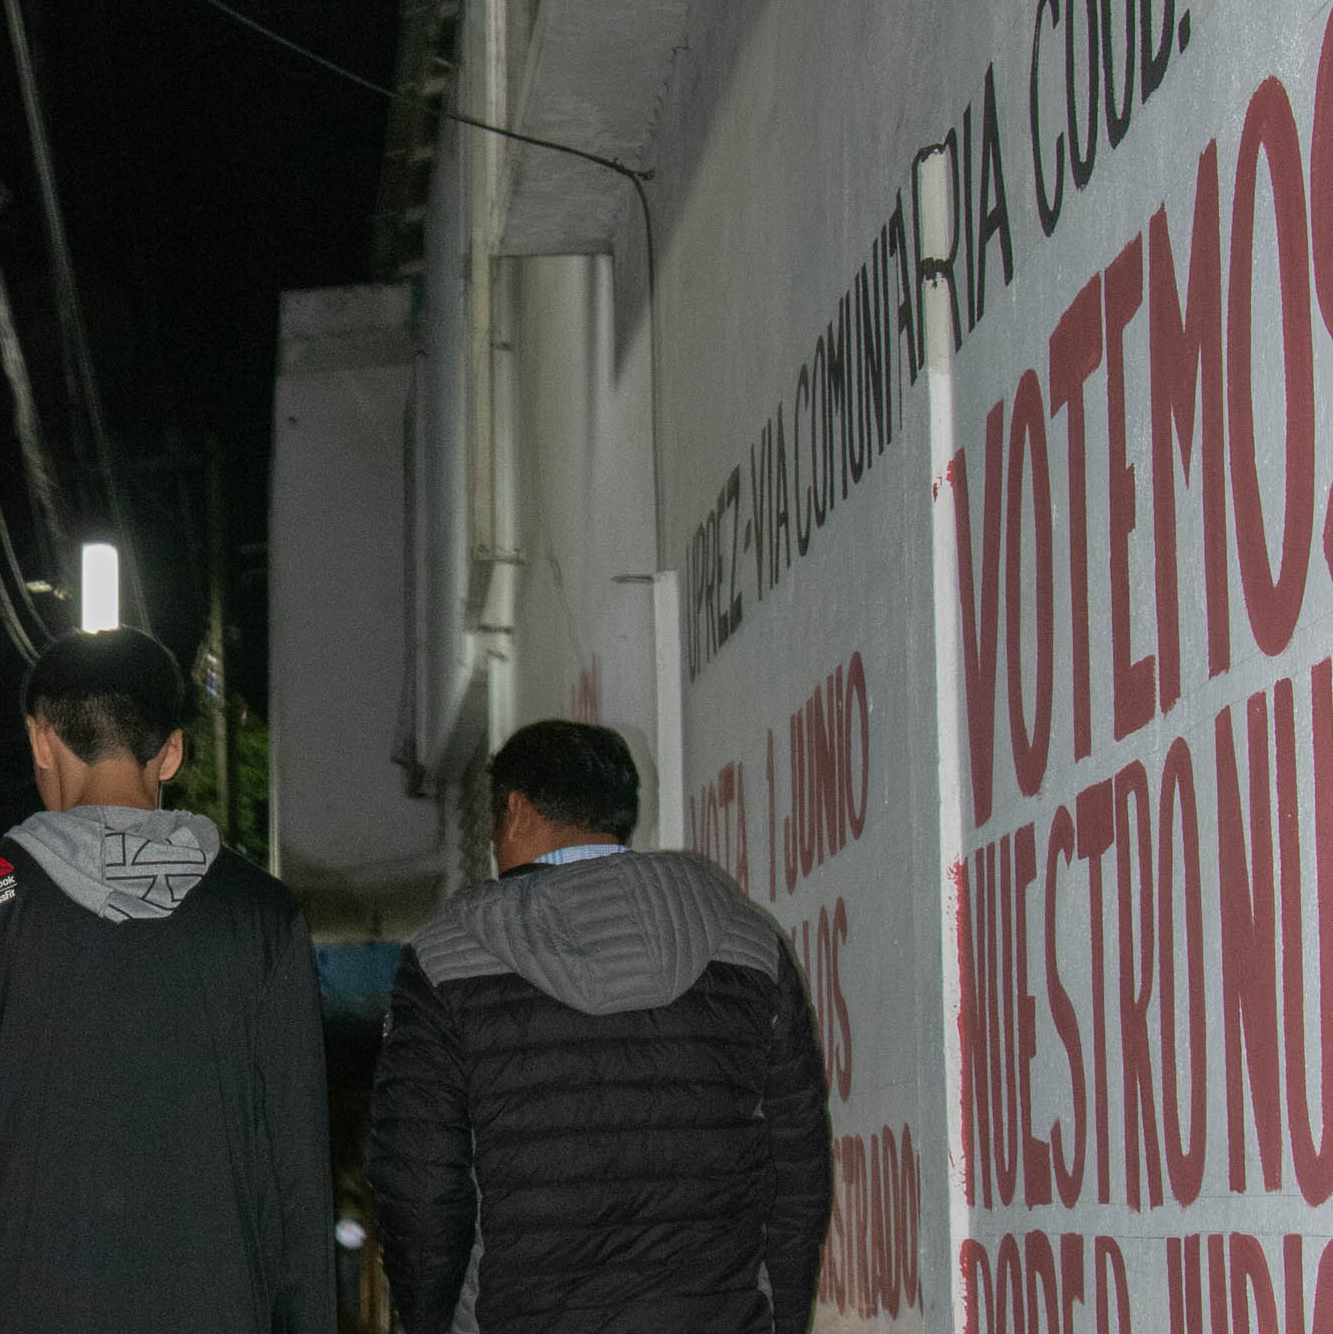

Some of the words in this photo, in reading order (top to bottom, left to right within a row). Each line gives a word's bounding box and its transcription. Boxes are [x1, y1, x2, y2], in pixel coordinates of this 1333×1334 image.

[793, 63, 1014, 557] COMUNITARIA
[949, 5, 1333, 828] VOTEMO
[783, 650, 869, 895] JUNIO
[955, 736, 1207, 1213] NUESTRO
